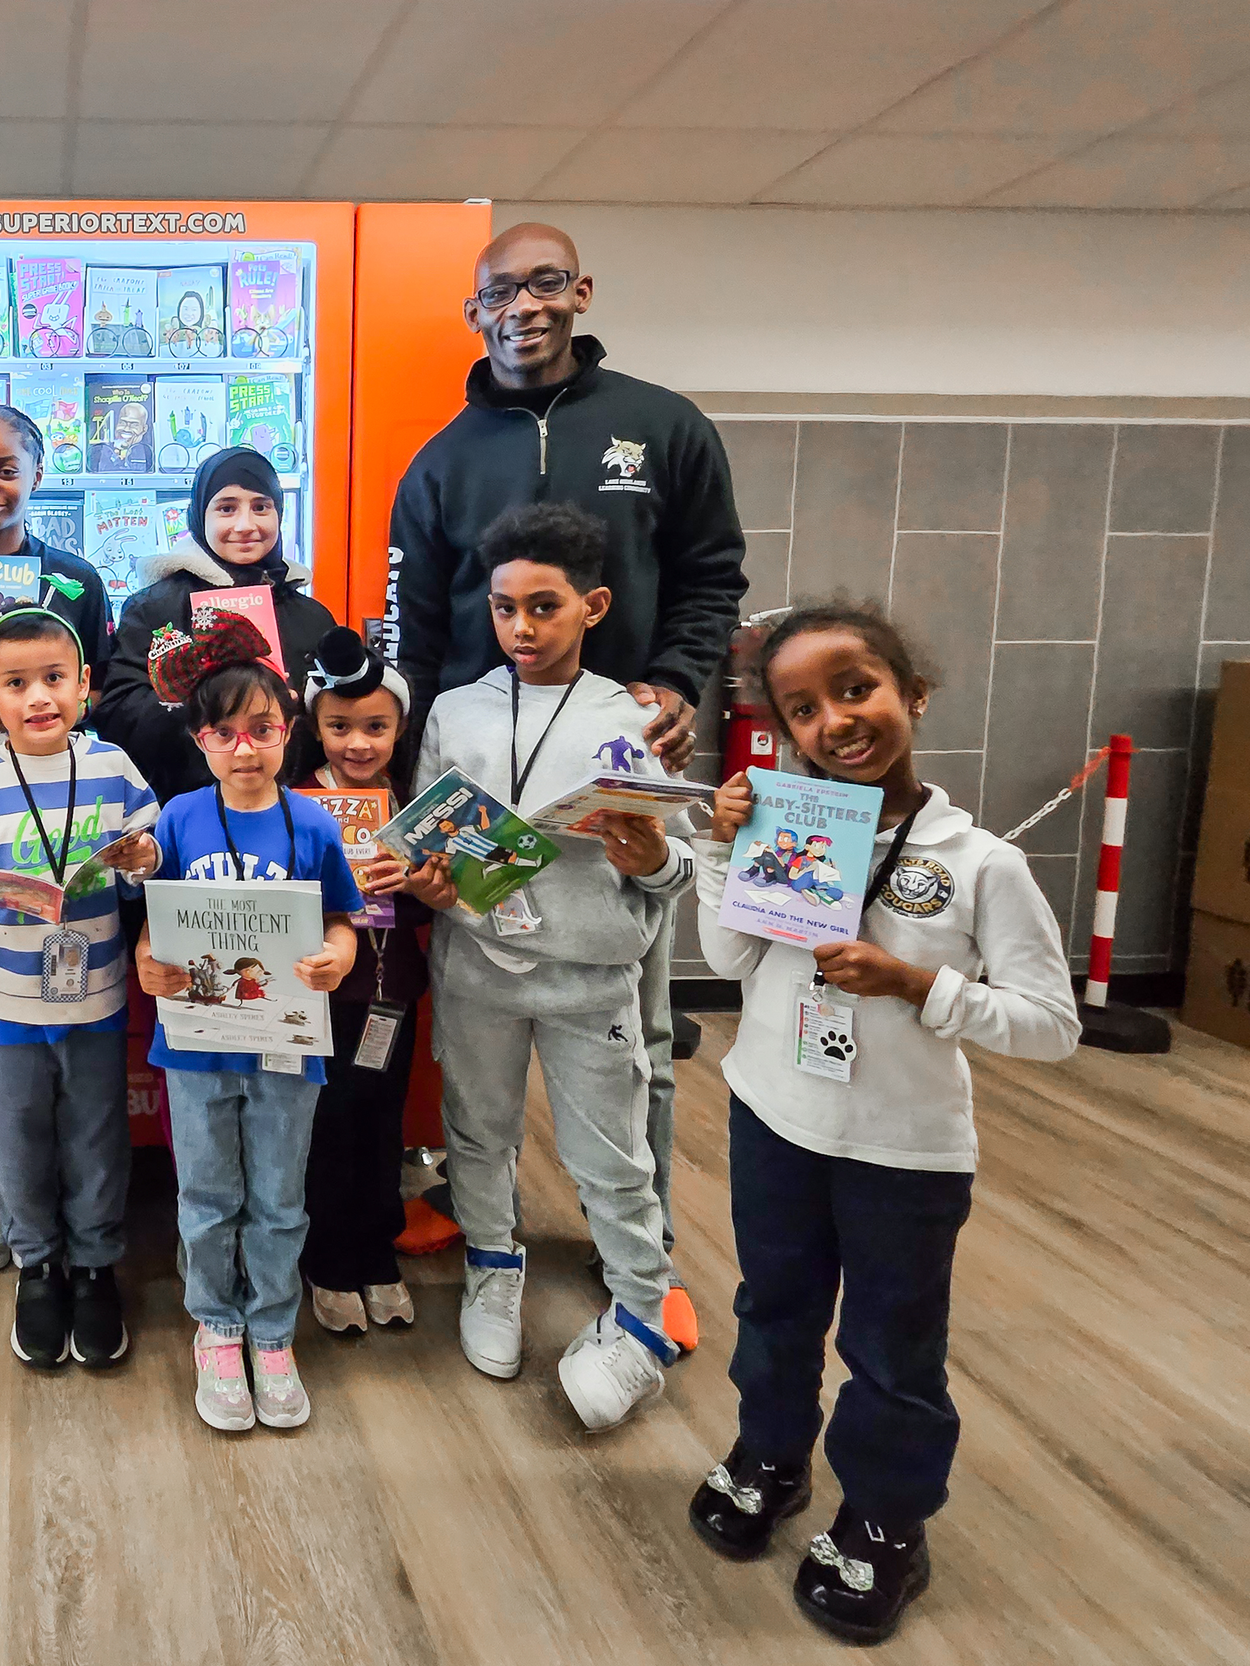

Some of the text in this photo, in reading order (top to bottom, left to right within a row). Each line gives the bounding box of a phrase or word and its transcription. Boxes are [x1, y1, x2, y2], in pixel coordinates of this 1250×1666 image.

[20, 262, 63, 278] PRESS
[21, 271, 66, 292] START!
[239, 271, 280, 288] RULE!
[33, 385, 58, 397] COOL
[230, 384, 271, 400] PRESS
[230, 393, 274, 413] START!
[124, 508, 144, 516] Lost
[32, 516, 76, 538] BAD
[96, 516, 148, 535] MITTEN
[200, 594, 264, 610] allergic
[776, 782, 813, 792] GABRIELA
[816, 788, 849, 798] EPSTEIN
[800, 792, 820, 803] THE
[403, 787, 474, 846] MESSI
[752, 792, 872, 824] BABY-SITTERS
[336, 816, 350, 824] nd
[784, 812, 828, 829] CLUB
[12, 795, 103, 865] Good
[924, 861, 951, 886] ROAD
[206, 898, 258, 912] THE MOST
[176, 909, 292, 934] MAGNIFICENT
[732, 900, 766, 914] CLAUDIA
[768, 910, 787, 920] AND
[790, 914, 804, 924] THE
[806, 919, 828, 929] NEW
[830, 925, 850, 936] GIRL
[208, 931, 260, 952] THING
[211, 1012, 265, 1021] ASHLEY SPIRES
